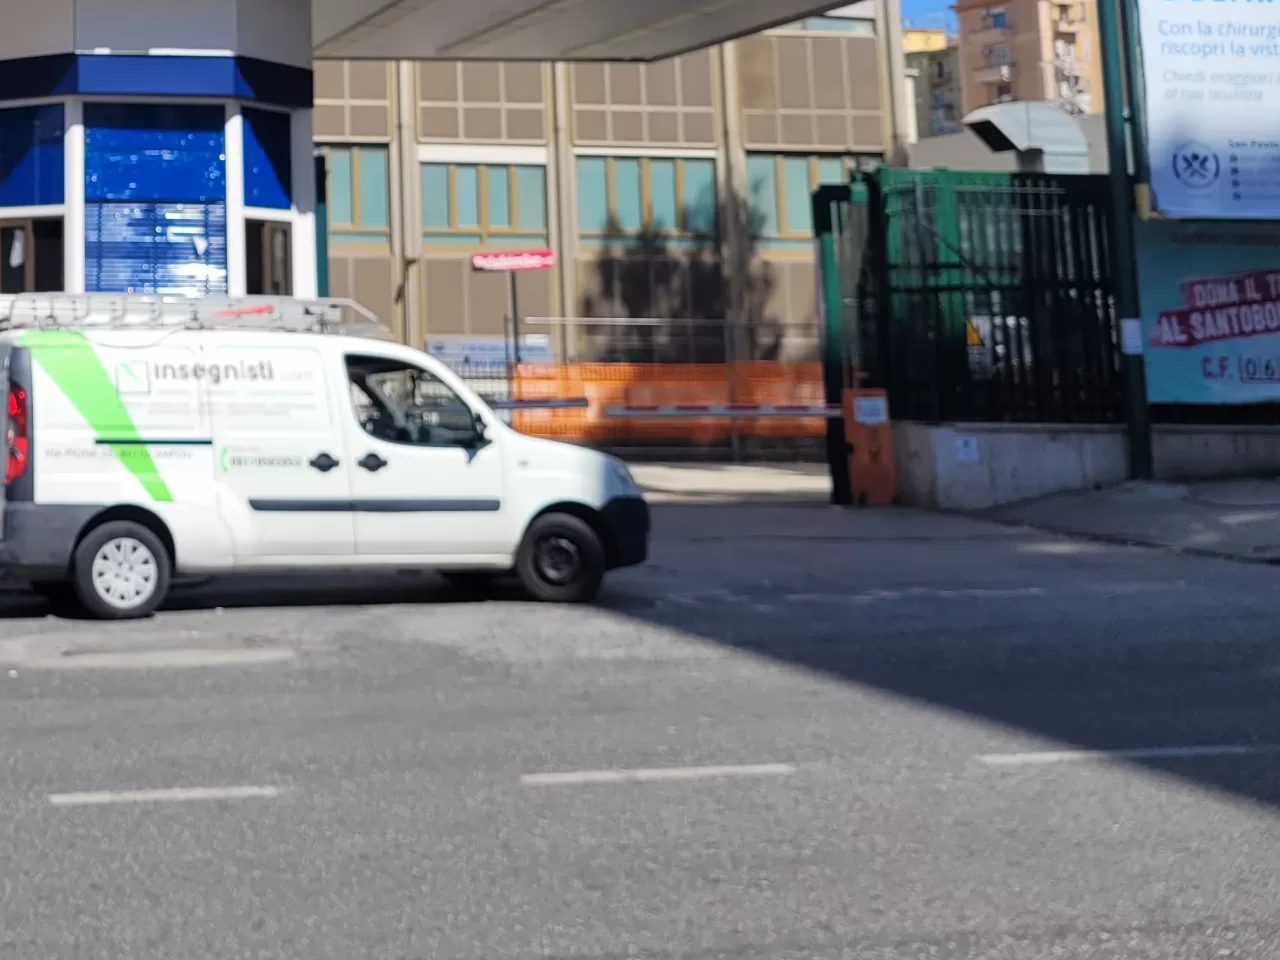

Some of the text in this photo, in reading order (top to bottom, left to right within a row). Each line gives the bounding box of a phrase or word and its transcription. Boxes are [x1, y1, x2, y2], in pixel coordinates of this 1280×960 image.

[1158, 19, 1193, 36] Con
[1196, 19, 1213, 36] la
[1160, 40, 1225, 59] riscopri
[1230, 40, 1246, 57] la
[1194, 282, 1239, 308] DONA
[1245, 278, 1262, 301] IL
[1161, 315, 1188, 344] AL
[154, 360, 275, 383] insegnisti
[1201, 355, 1234, 378] C.F.
